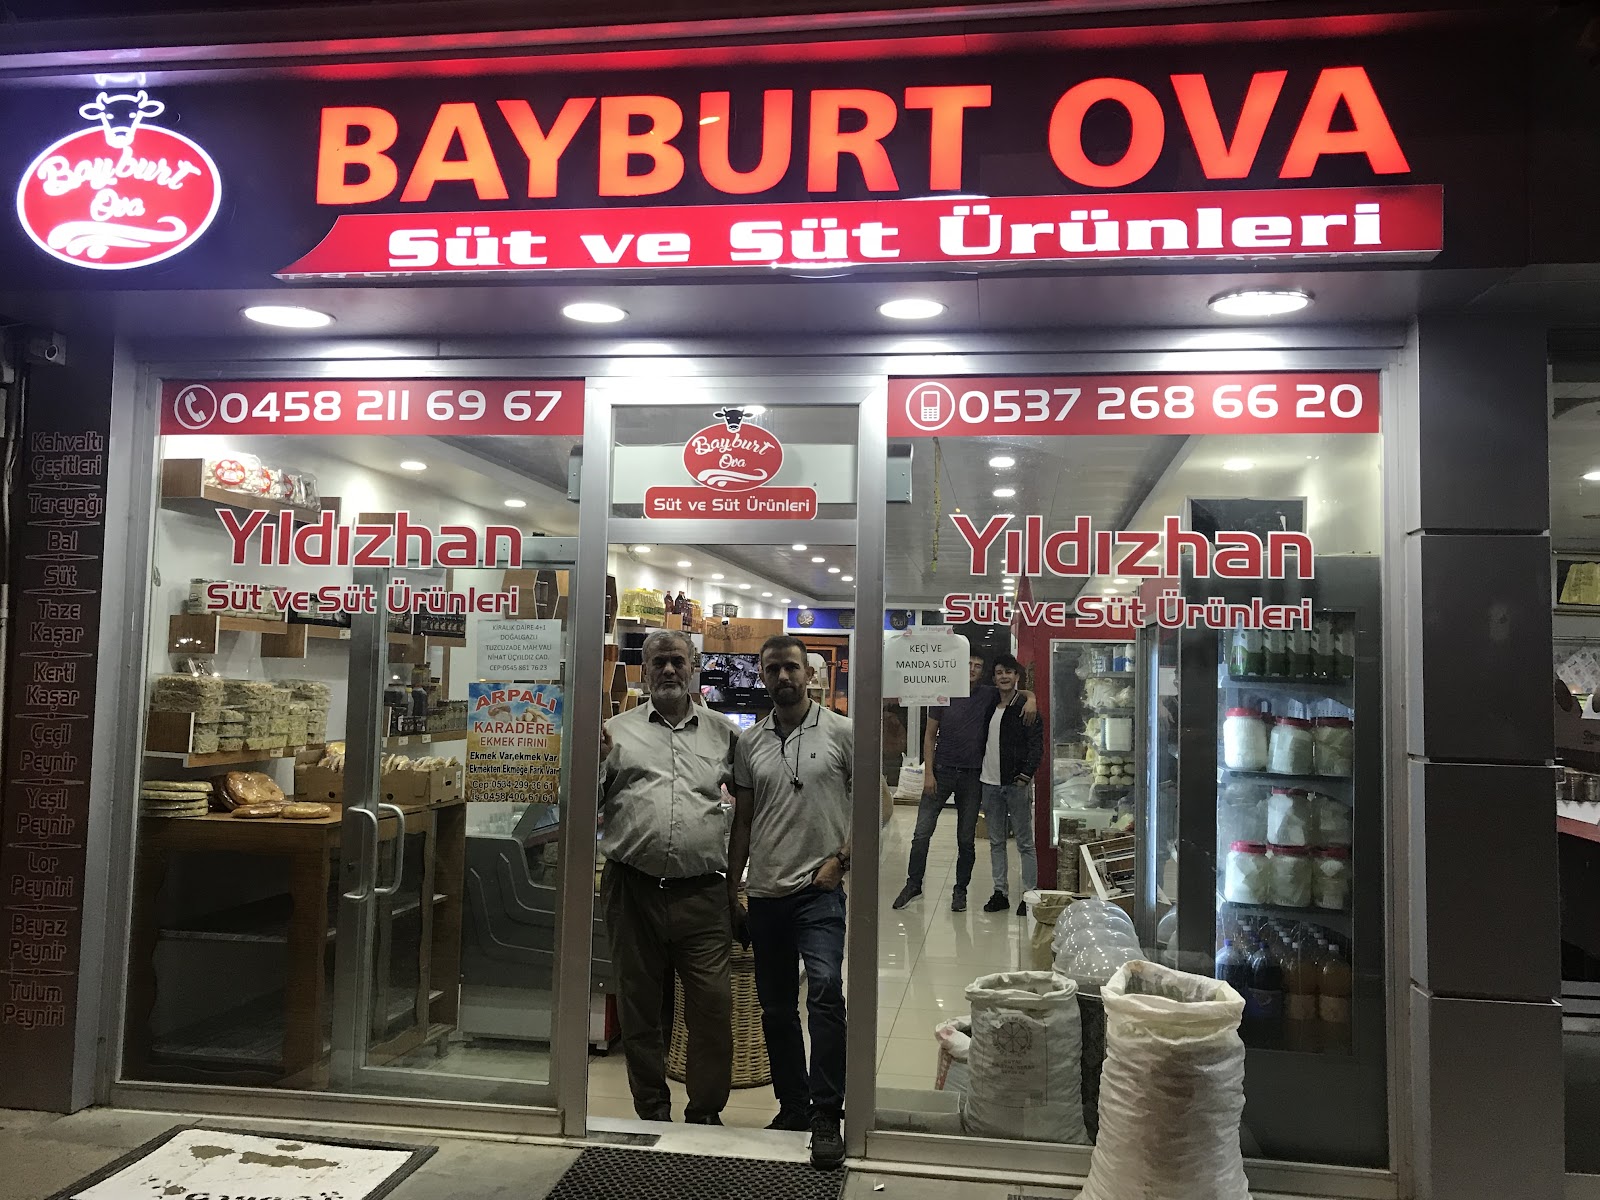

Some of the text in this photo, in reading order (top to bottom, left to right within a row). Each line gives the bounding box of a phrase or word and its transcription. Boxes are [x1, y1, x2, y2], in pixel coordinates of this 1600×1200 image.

[316, 66, 1411, 204] BAYBURT OVA
[37, 146, 201, 196] Bayburt
[90, 191, 145, 220] Ova
[388, 203, 1382, 267] Süt ve Süt Ürünleri
[219, 389, 563, 424] 0458 211 69 67
[958, 383, 1363, 424] 0537 268 66 20
[31, 431, 103, 452] Kahvaltı
[692, 433, 776, 456] Bayburt
[32, 455, 102, 480] Çeşitleri
[718, 453, 746, 469] Ova
[28, 493, 103, 518] Tereyağı
[653, 495, 810, 512] Süt ve Süt Ürünleri
[47, 530, 77, 551] Bal
[215, 508, 523, 568] Yıldızhan
[948, 513, 1315, 580] Yıldızhan
[44, 565, 77, 586] Süt
[206, 577, 520, 615] Süt ve Süt Ürünleri
[38, 600, 81, 620] Taze
[943, 590, 1313, 631] Süt ve Süt Ürünleri
[30, 623, 83, 647] Kaşar
[909, 643, 942, 654] KEÇİ VE
[33, 662, 75, 682] Kerti
[896, 659, 957, 669] MANDA SÜTÜ
[903, 675, 950, 684] BULUNUR.
[26, 685, 79, 710] Kaşar
[475, 689, 557, 714] ARPALI
[31, 723, 71, 746] Çeçil
[474, 721, 555, 735] KARADERE
[480, 737, 547, 748] EKMEK FIRINI
[20, 751, 77, 774] Peynir
[470, 751, 496, 760] Ekmek
[544, 753, 557, 762] Var
[469, 764, 500, 774] Ekmekten
[26, 788, 68, 813] Yeşil
[17, 813, 75, 838] Peynir
[28, 852, 58, 873] Lor
[11, 875, 73, 899] Peyniri
[12, 914, 67, 938] Beyaz
[9, 939, 66, 964] Peynir
[8, 981, 62, 1003] Tulum
[3, 1005, 65, 1028] Peyniri
